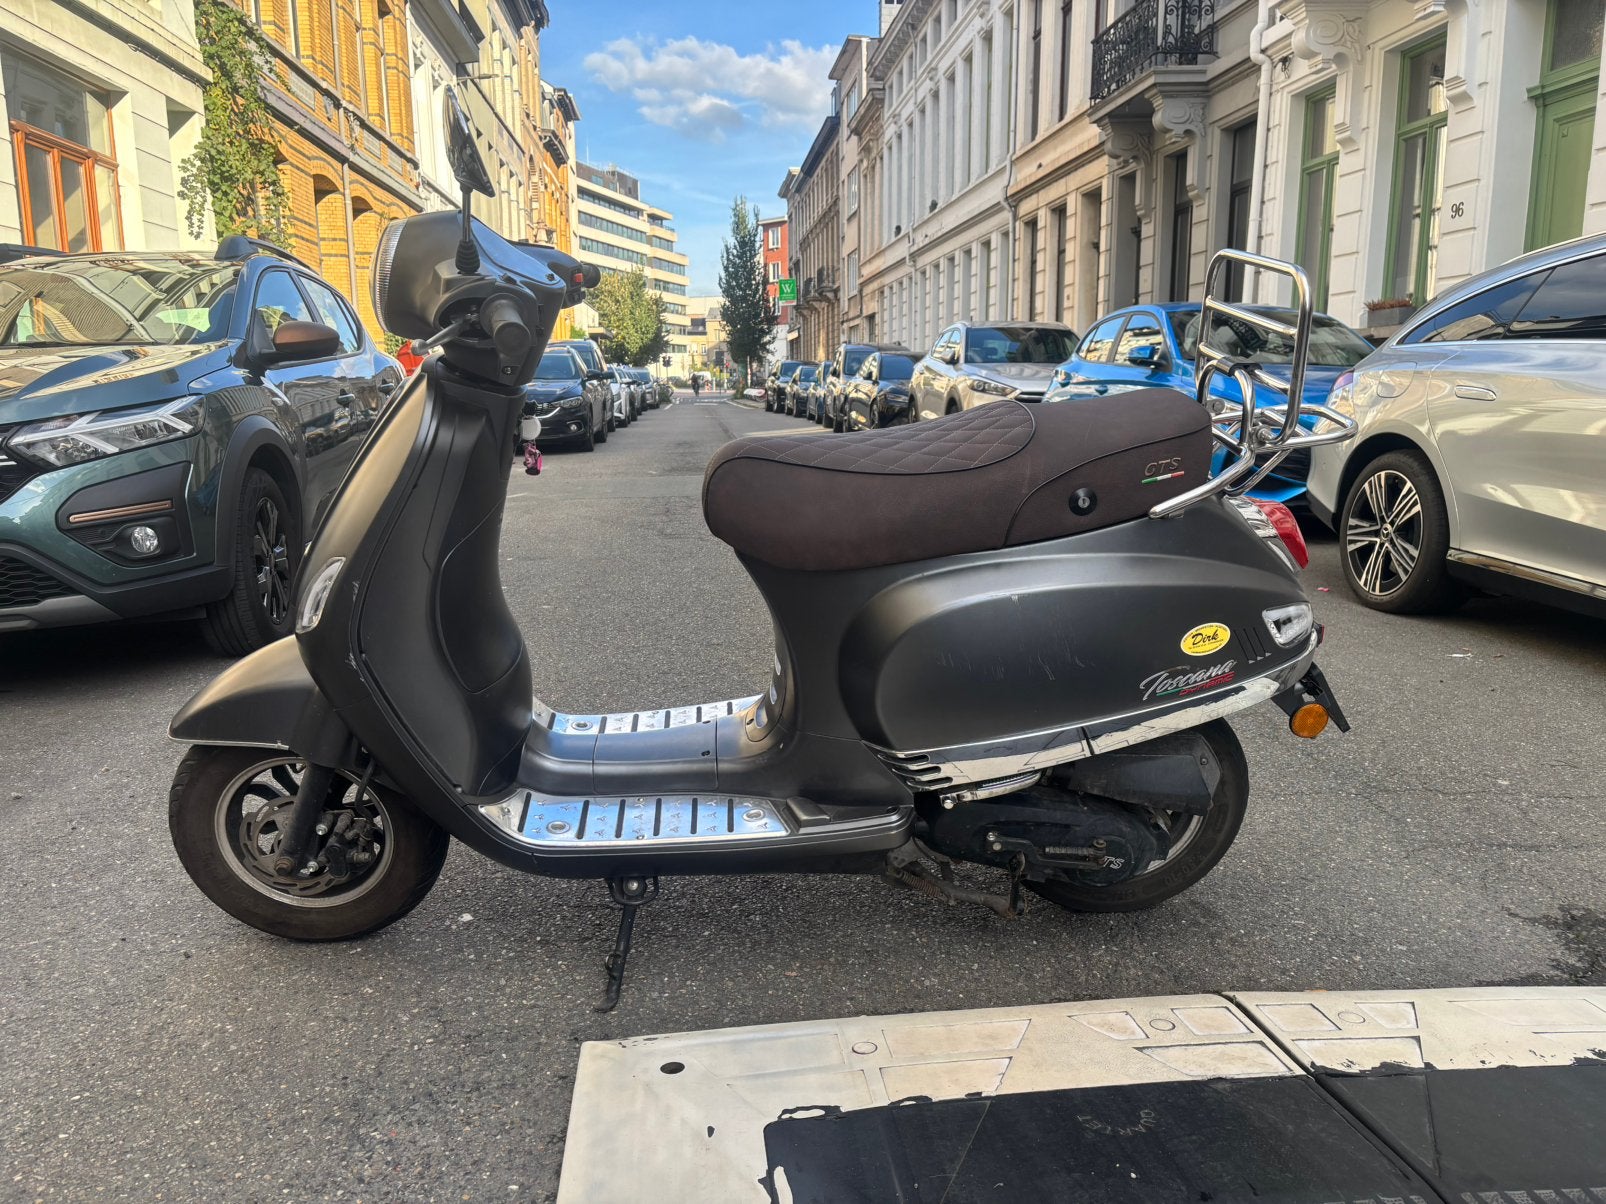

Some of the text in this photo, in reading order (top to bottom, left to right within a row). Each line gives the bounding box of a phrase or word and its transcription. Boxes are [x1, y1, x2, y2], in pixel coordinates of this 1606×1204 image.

[1451, 201, 1464, 219] 96
[781, 283, 793, 293] W
[1144, 457, 1182, 476] GTS
[1191, 628, 1219, 646] Dirk
[1139, 659, 1238, 701] Toscana
[1103, 855, 1125, 869] TS
